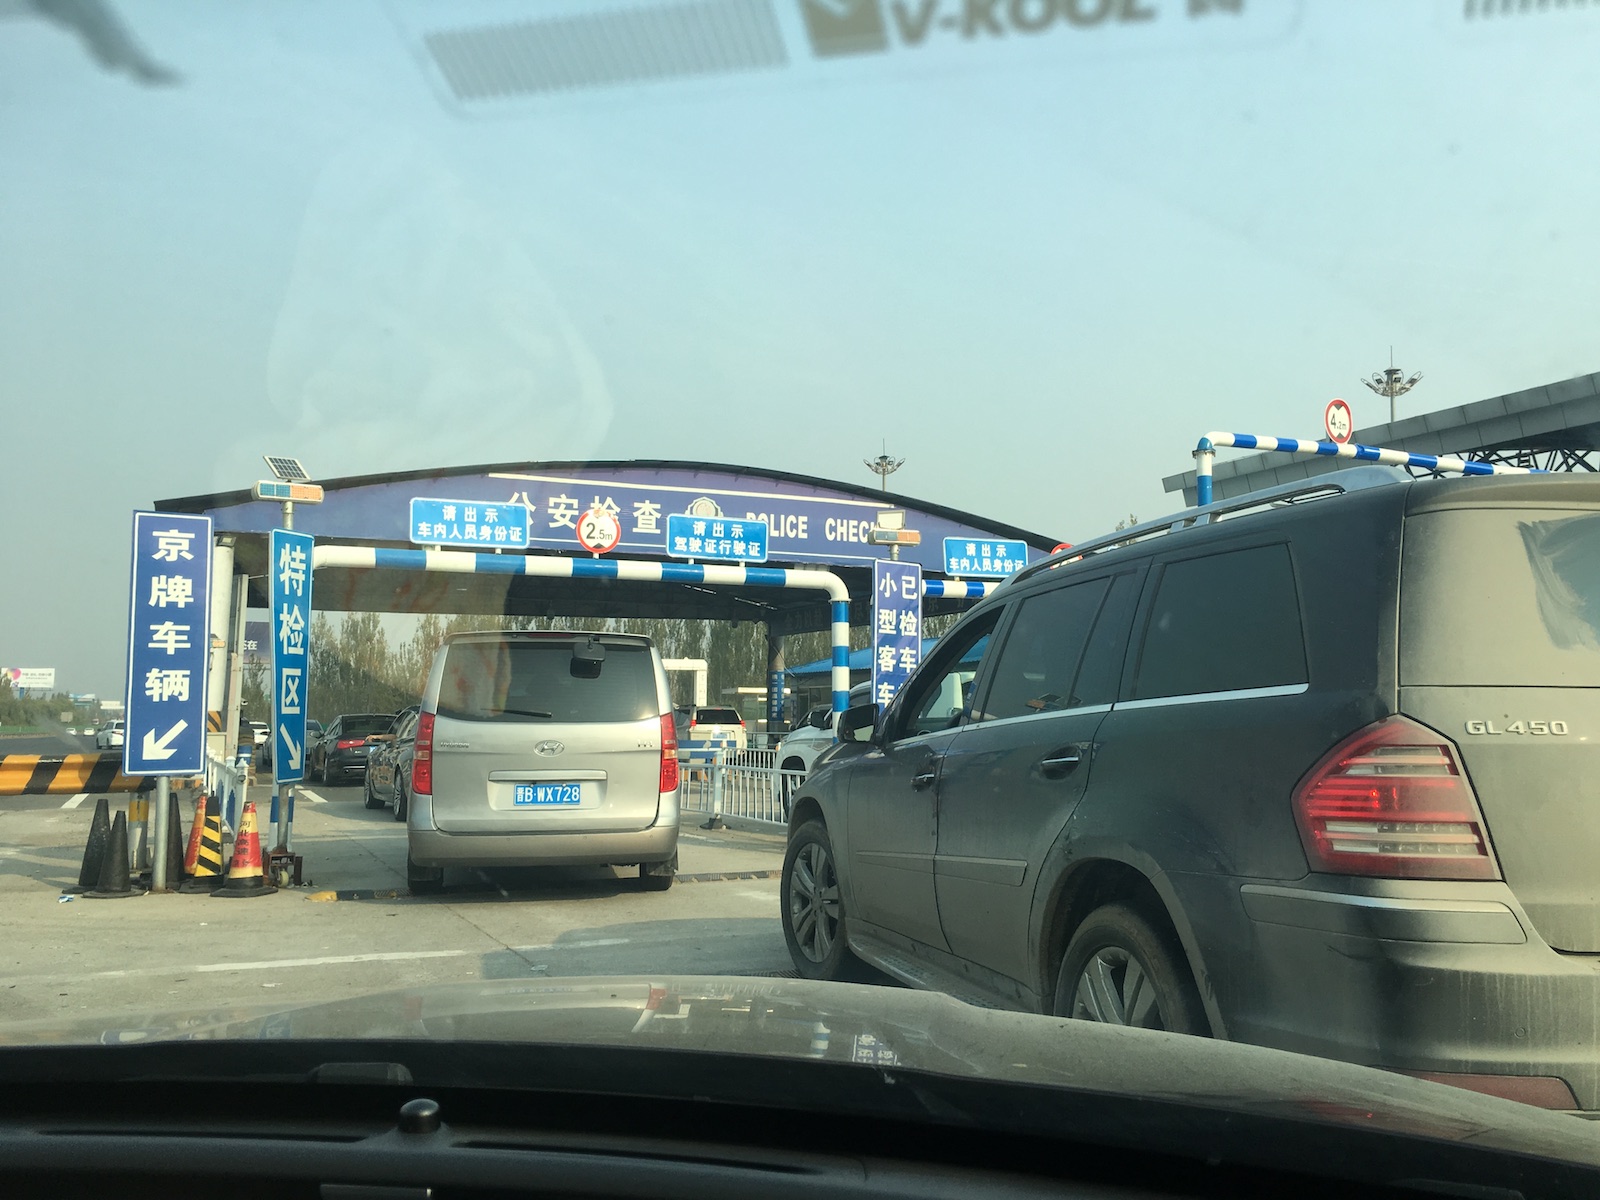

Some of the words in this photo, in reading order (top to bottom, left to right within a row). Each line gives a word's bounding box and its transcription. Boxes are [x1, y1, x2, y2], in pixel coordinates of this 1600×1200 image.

[442, 505, 499, 523] 请出示
[418, 522, 522, 542] 车内人员身份证
[585, 522, 613, 541] 2.5m
[693, 520, 744, 539] 请出示
[825, 517, 876, 544] CHEC
[674, 535, 761, 557] 驾驶证行驶证
[965, 542, 1007, 557] 请出示
[949, 557, 1024, 573] 车内人员身份证
[145, 528, 195, 702] 京牌车辆
[279, 542, 306, 715] 特检区
